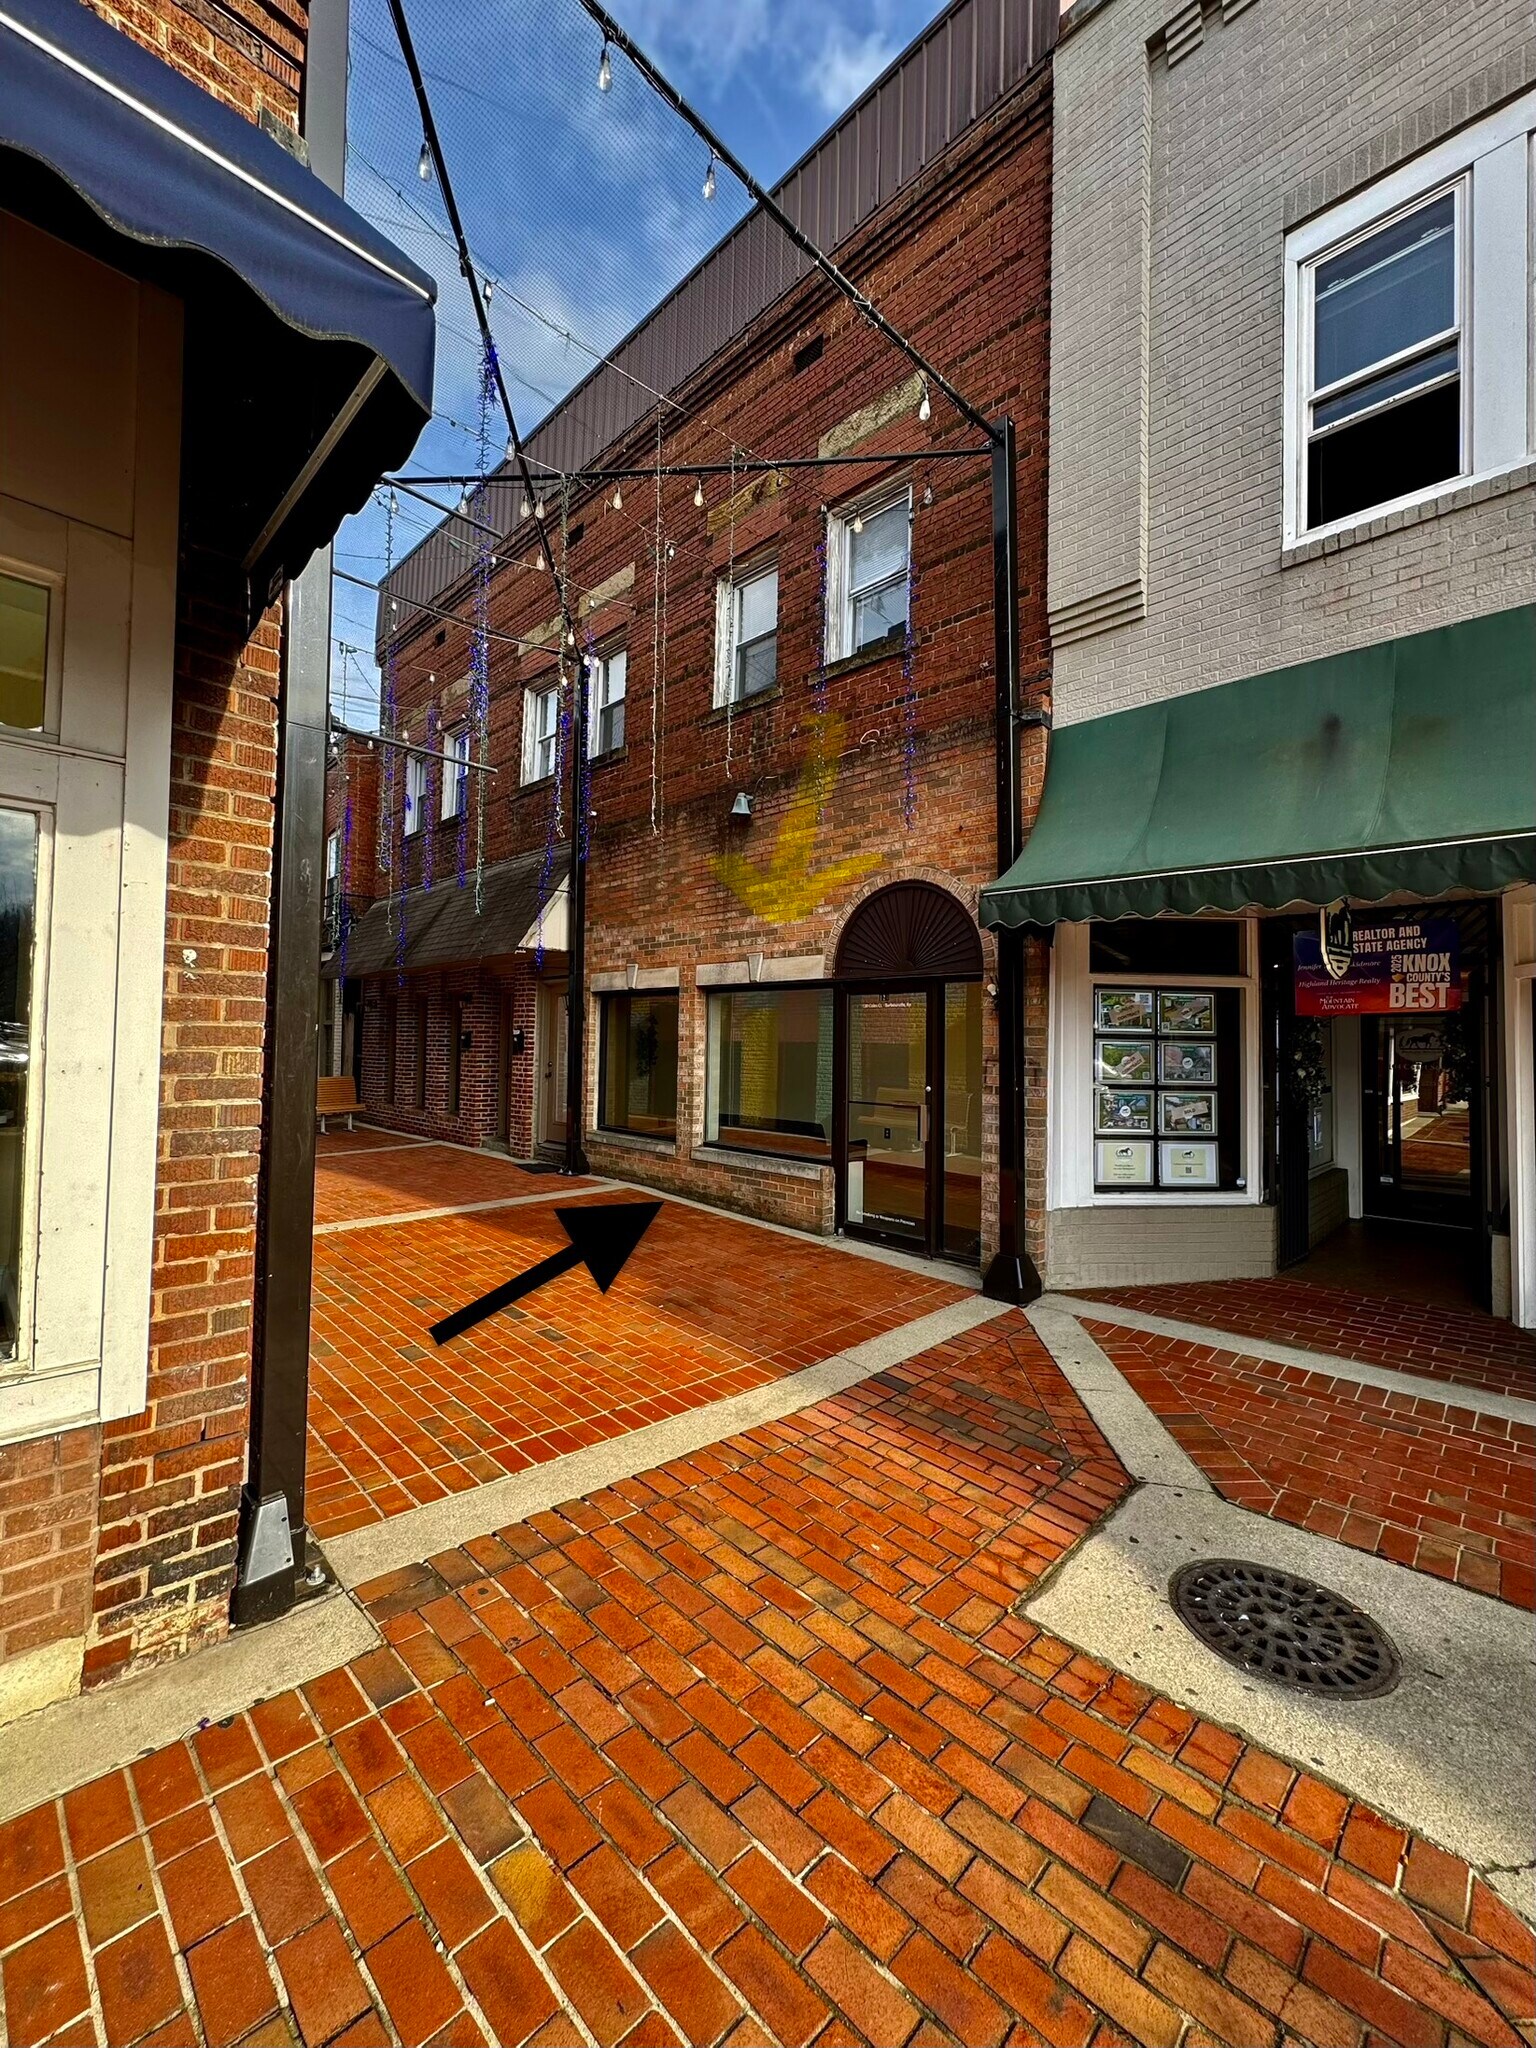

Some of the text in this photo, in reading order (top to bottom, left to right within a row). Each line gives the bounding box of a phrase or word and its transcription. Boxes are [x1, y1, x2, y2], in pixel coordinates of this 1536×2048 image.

[1352, 925, 1421, 942] REALTOR AND
[1352, 937, 1428, 954] STATE AGENCY
[1391, 954, 1402, 973] 2025
[1402, 952, 1451, 973] KNOX
[1299, 980, 1329, 988] Highland
[1406, 971, 1451, 982] COUNTY'S
[1389, 982, 1451, 1008] BEST
